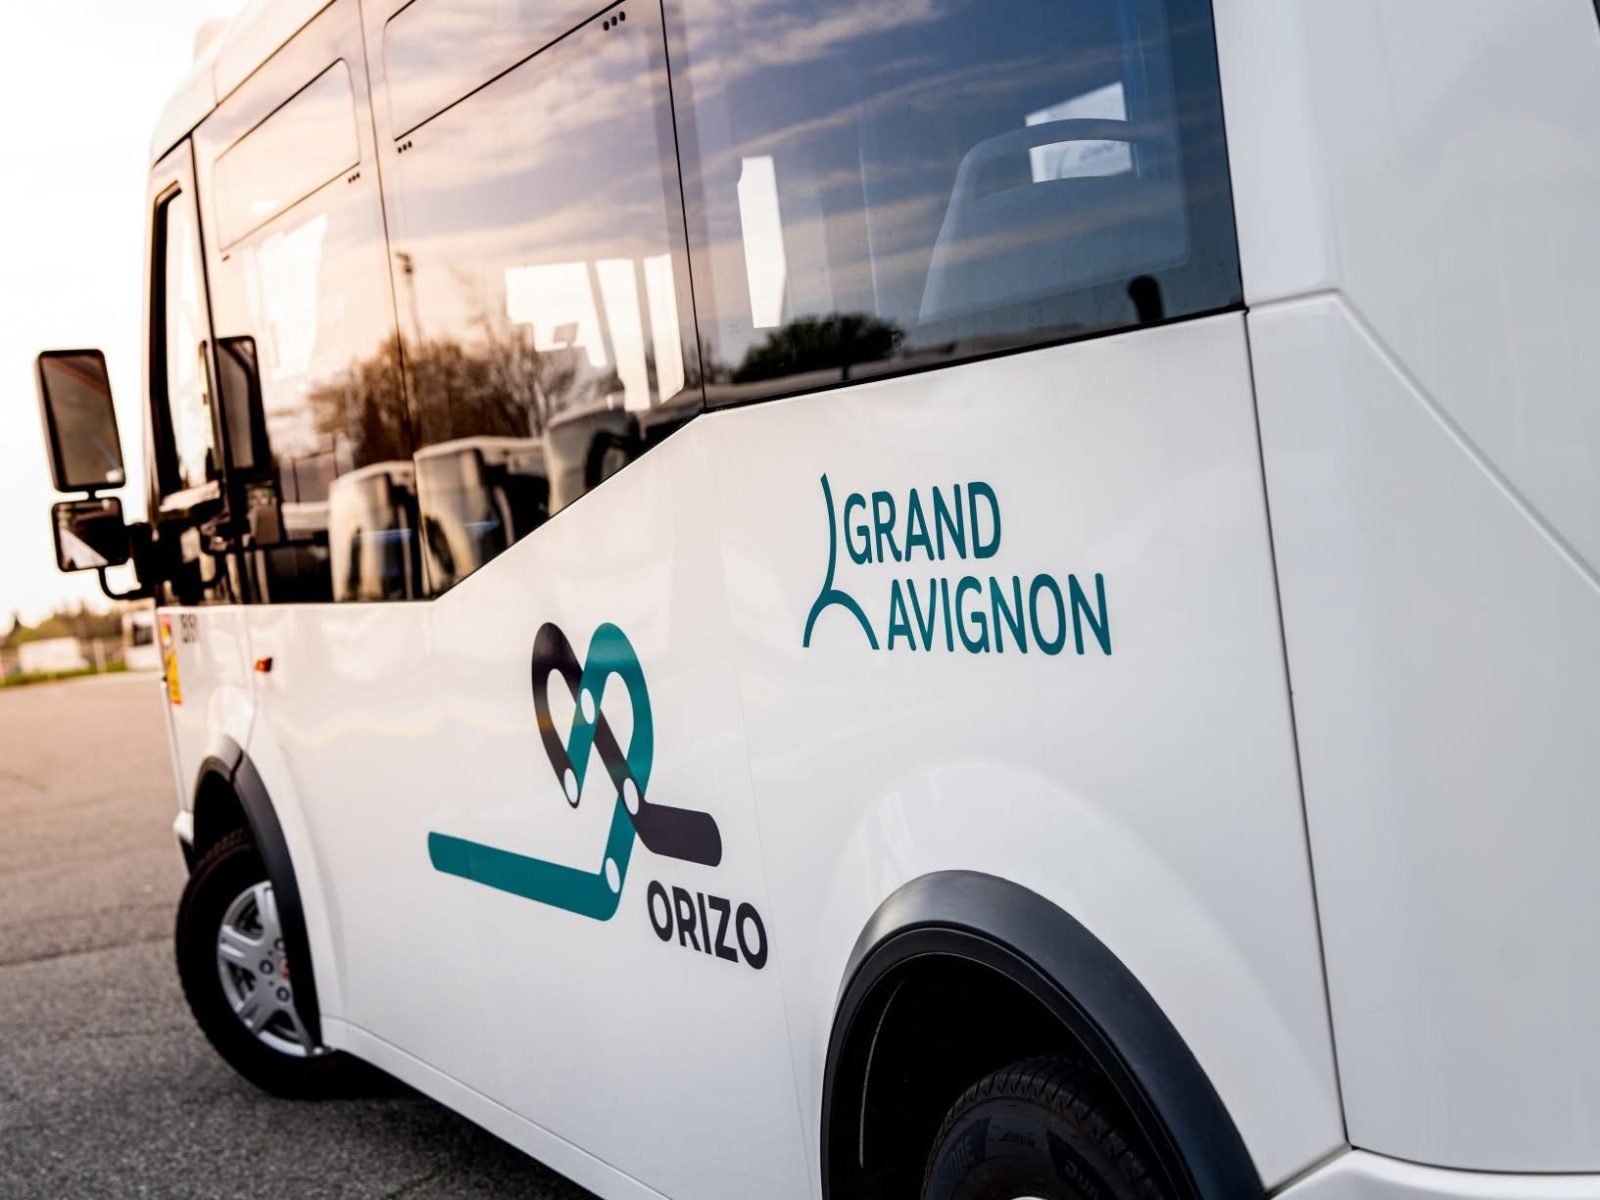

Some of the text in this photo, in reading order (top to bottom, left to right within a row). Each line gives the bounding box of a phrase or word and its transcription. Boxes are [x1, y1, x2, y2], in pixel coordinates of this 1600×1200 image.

[844, 481, 1002, 565] GRAND
[887, 572, 1112, 656] AVIGNON
[647, 879, 769, 970] ORIZO
